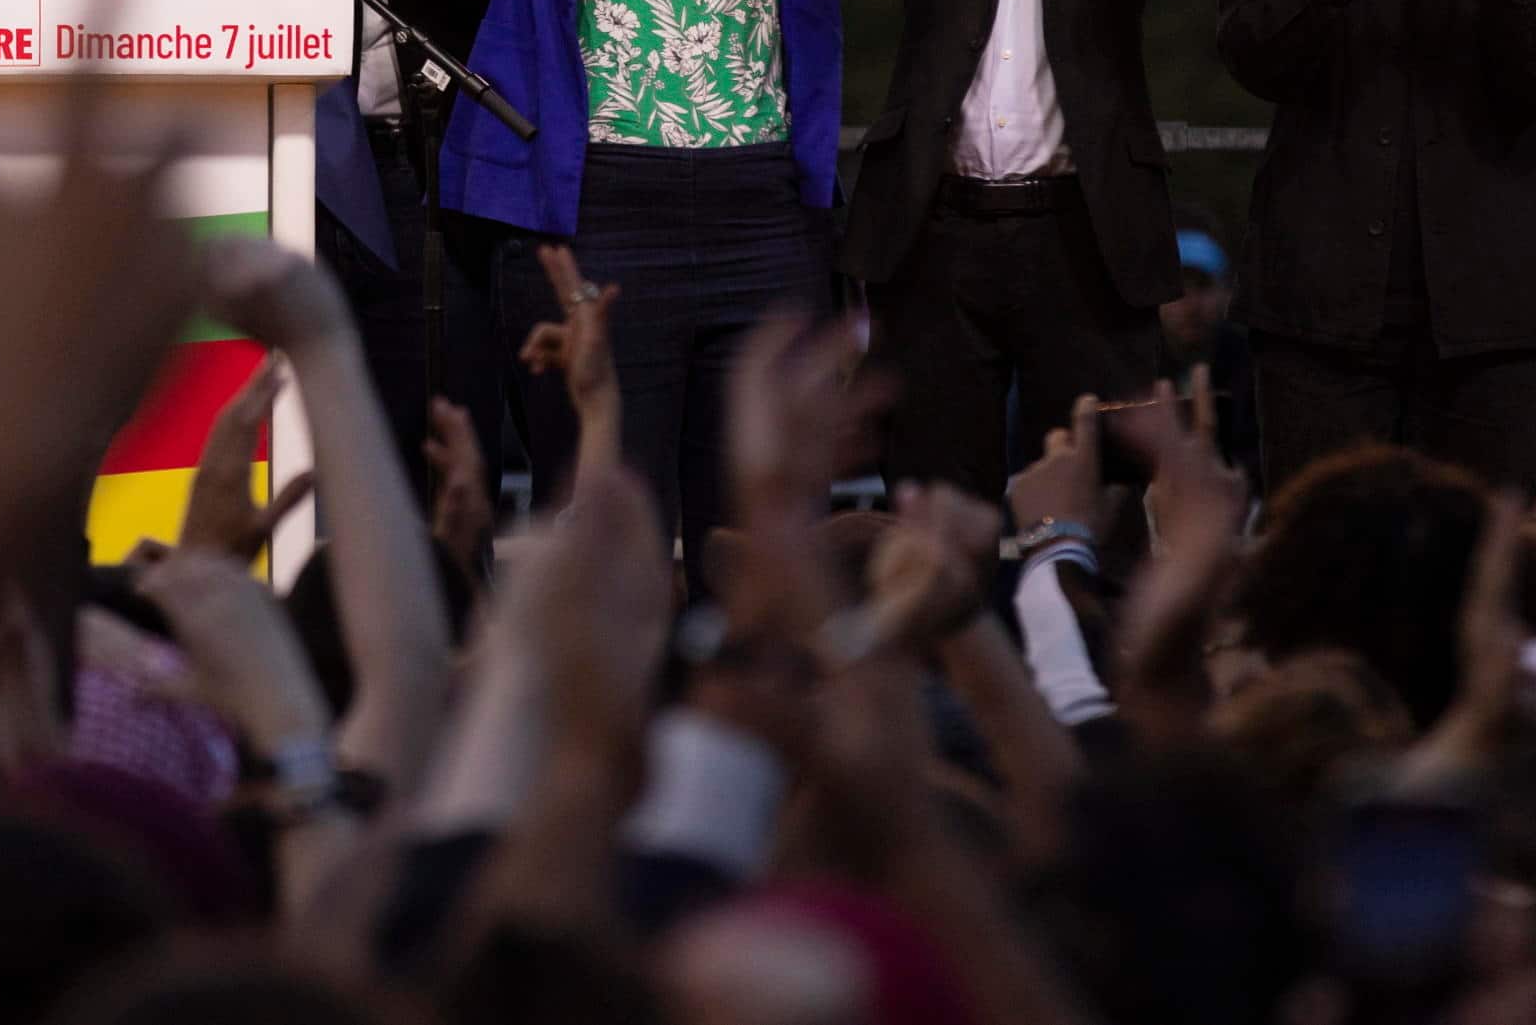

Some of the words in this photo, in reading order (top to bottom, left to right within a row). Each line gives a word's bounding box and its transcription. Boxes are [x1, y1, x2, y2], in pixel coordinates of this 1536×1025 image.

[55, 23, 213, 60] Dimanche
[220, 24, 240, 60] 7
[244, 23, 334, 70] juillet
